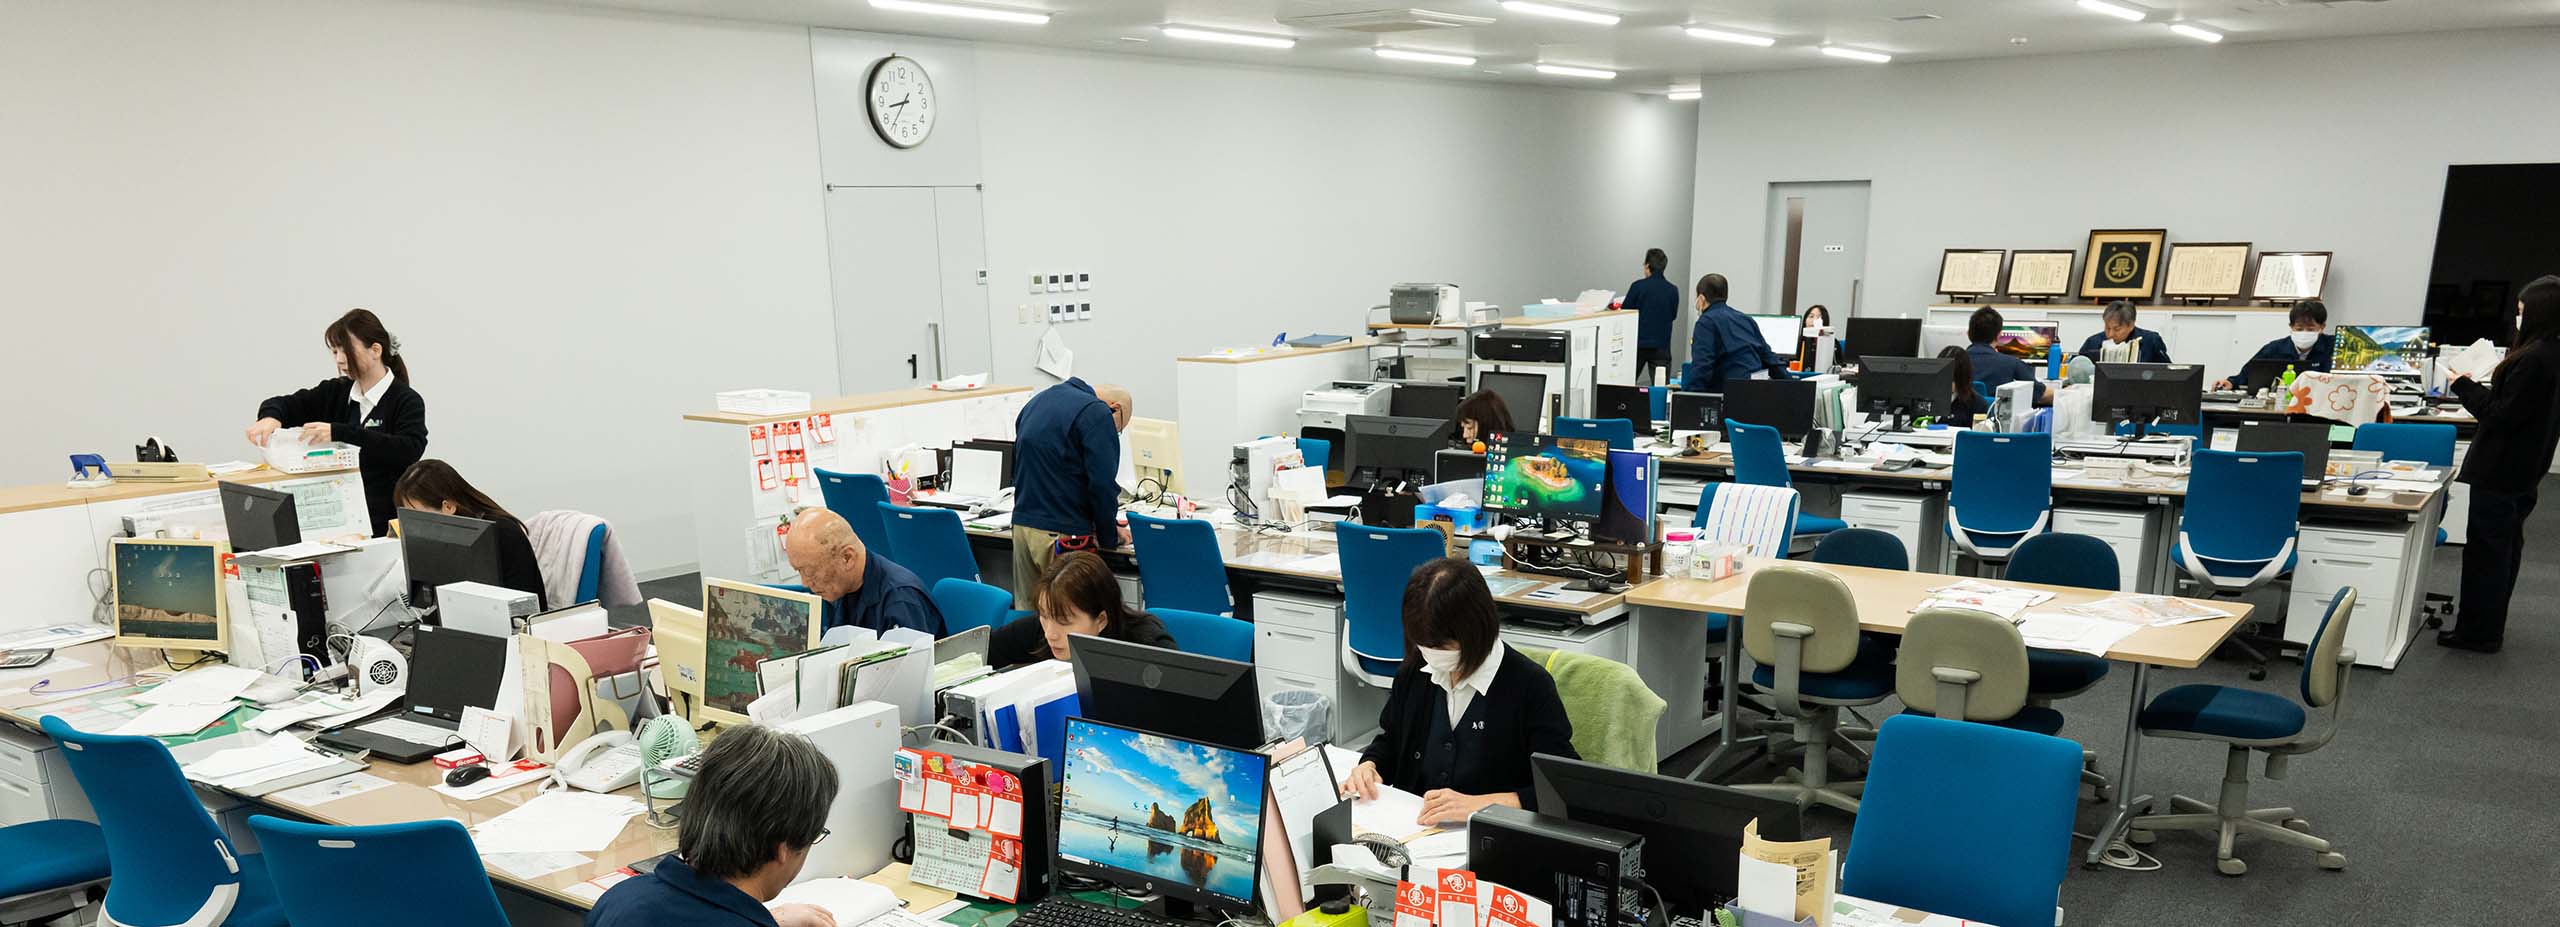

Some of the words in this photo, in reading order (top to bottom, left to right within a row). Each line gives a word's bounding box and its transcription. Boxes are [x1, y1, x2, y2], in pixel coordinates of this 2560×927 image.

[887, 70, 896, 83] 11
[897, 66, 906, 80] 12
[880, 81, 890, 93] 10
[918, 82, 924, 95] 2
[878, 95, 885, 108] 9
[920, 97, 928, 110] 3
[883, 112, 890, 125] 8
[919, 113, 925, 124] 4
[901, 126, 908, 138] 6
[911, 123, 918, 136] 5
[455, 757, 480, 767] docomo
